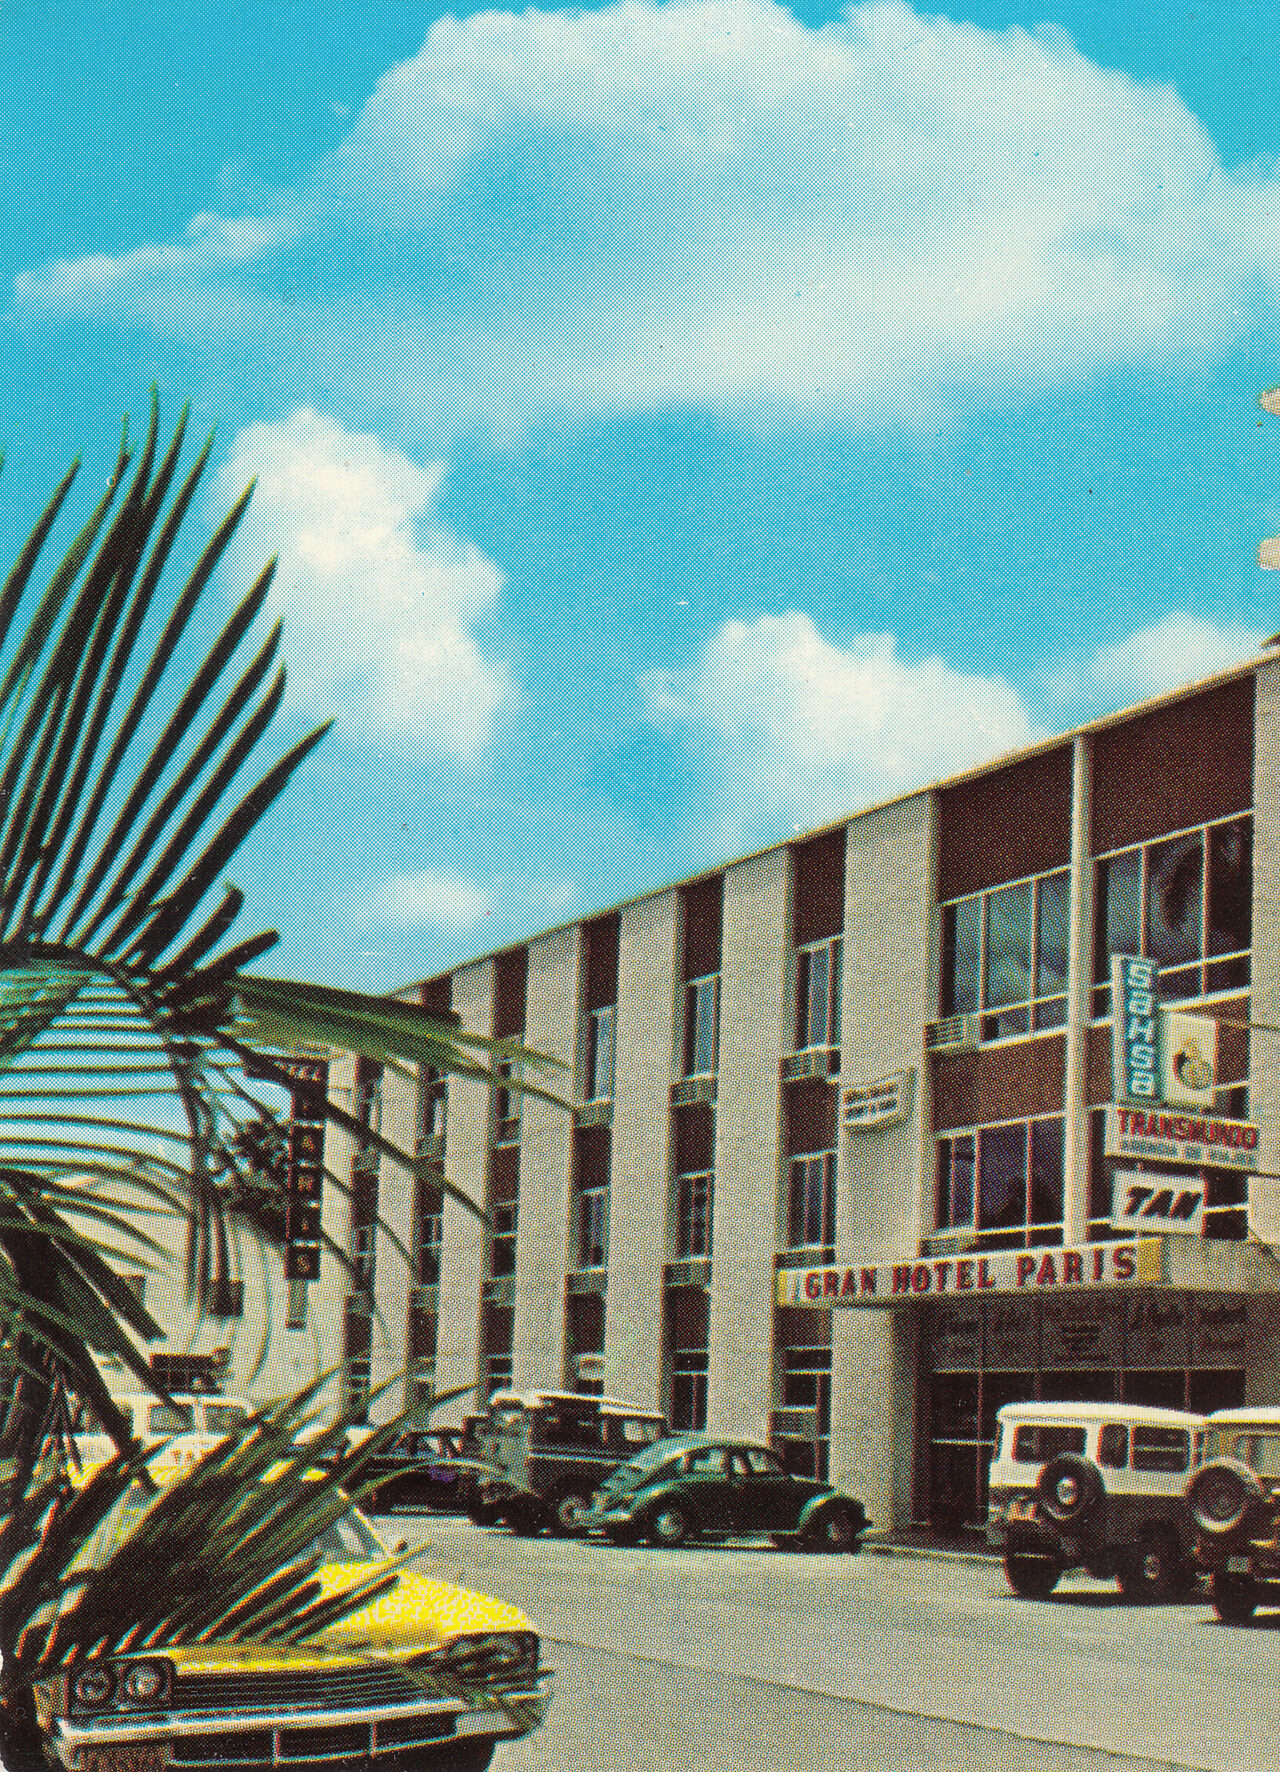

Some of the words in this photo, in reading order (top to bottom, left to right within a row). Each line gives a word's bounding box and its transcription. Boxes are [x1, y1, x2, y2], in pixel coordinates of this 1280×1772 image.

[1116, 1108, 1259, 1151] TRANSMUNDO
[1124, 1186, 1203, 1221] TAN
[804, 1267, 877, 1300] GRAN
[891, 1256, 996, 1295] HOTEL
[1016, 1245, 1137, 1287] PARIS
